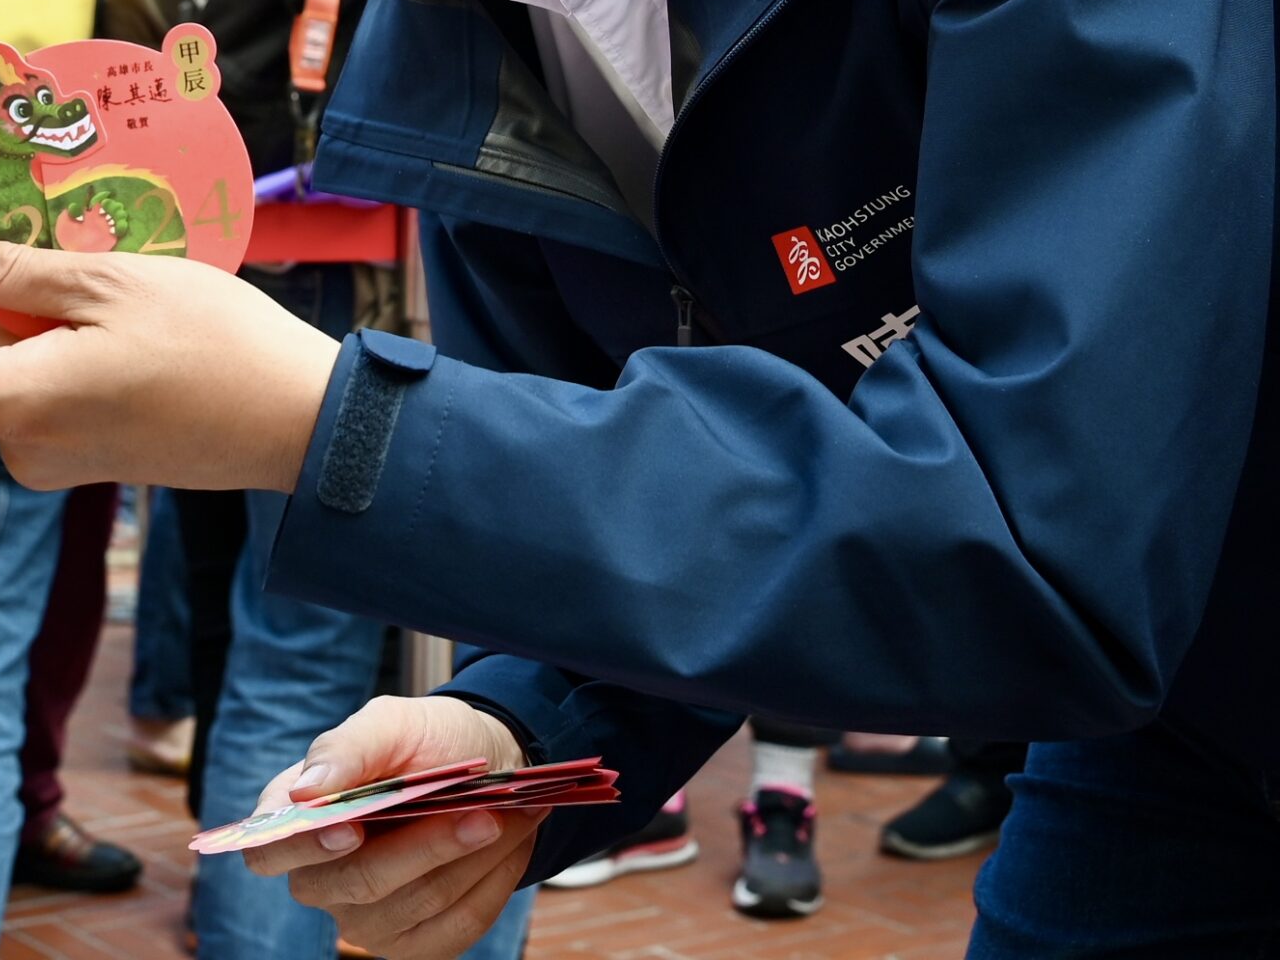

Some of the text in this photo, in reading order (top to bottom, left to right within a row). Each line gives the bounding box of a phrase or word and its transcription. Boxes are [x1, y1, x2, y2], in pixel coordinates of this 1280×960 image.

[107, 61, 154, 78] 高雄市長
[179, 40, 206, 94] 甲辰
[816, 185, 911, 243] KAOHSIUNG
[826, 237, 856, 258] CITY
[835, 216, 915, 272] GOVERNME
